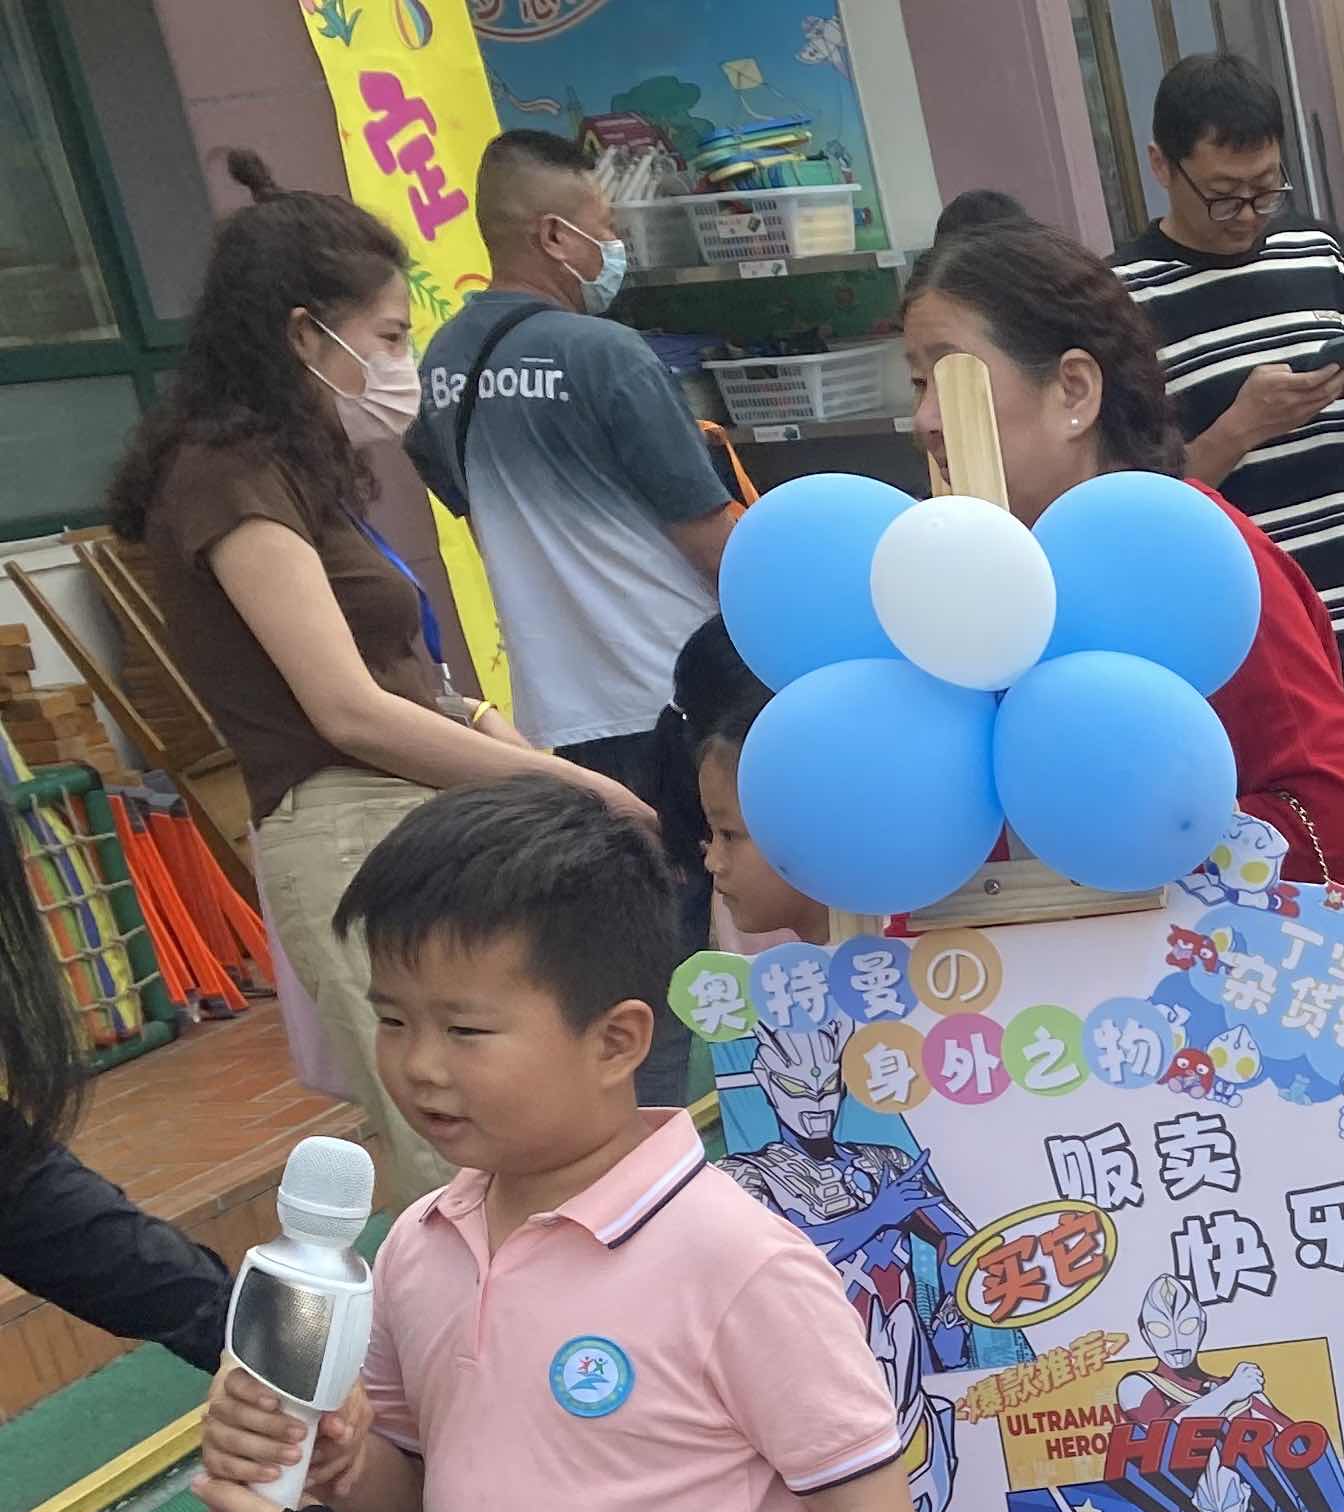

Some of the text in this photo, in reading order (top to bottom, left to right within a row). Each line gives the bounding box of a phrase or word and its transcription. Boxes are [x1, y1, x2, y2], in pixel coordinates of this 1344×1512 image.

[431, 366, 569, 408] Babour.
[686, 948, 988, 1032] 奥特曼の
[864, 1017, 1164, 1104] 身外之物
[1047, 1111, 1242, 1210] 贩卖
[978, 1211, 1105, 1323] 买它
[1046, 1432, 1113, 1461] HERO
[1103, 1416, 1329, 1482] HERO
